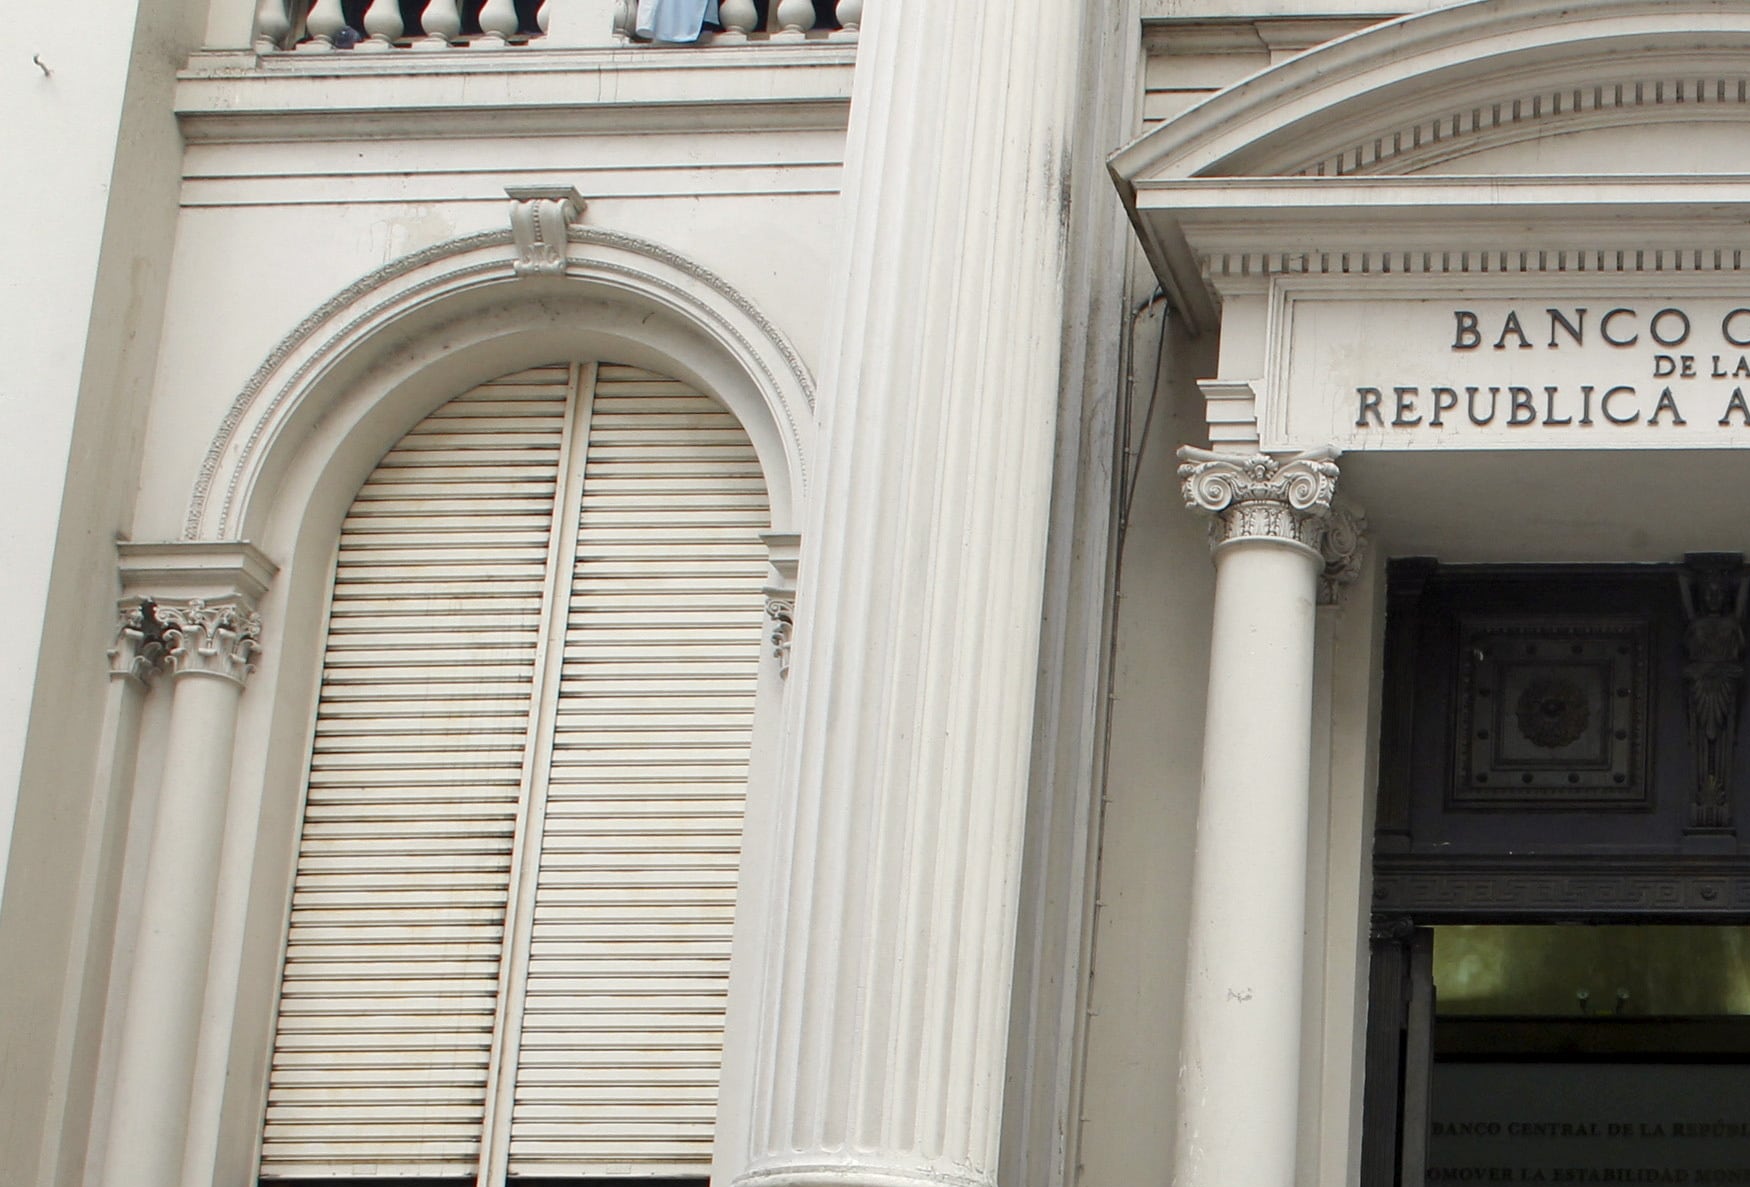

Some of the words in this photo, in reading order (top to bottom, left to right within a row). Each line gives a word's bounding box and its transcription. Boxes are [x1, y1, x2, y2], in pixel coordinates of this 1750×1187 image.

[1452, 308, 1691, 350] BANCO
[1653, 355, 1696, 378] DE
[1356, 386, 1686, 426] REPUBLICA
[1508, 1121, 1600, 1137] CENTRAL
[1608, 1122, 1634, 1137] DE
[1640, 1122, 1665, 1137] LA
[1426, 1167, 1513, 1182] OMOVER
[1521, 1168, 1545, 1182] LA
[1552, 1168, 1689, 1182] ESTABILIDAD
